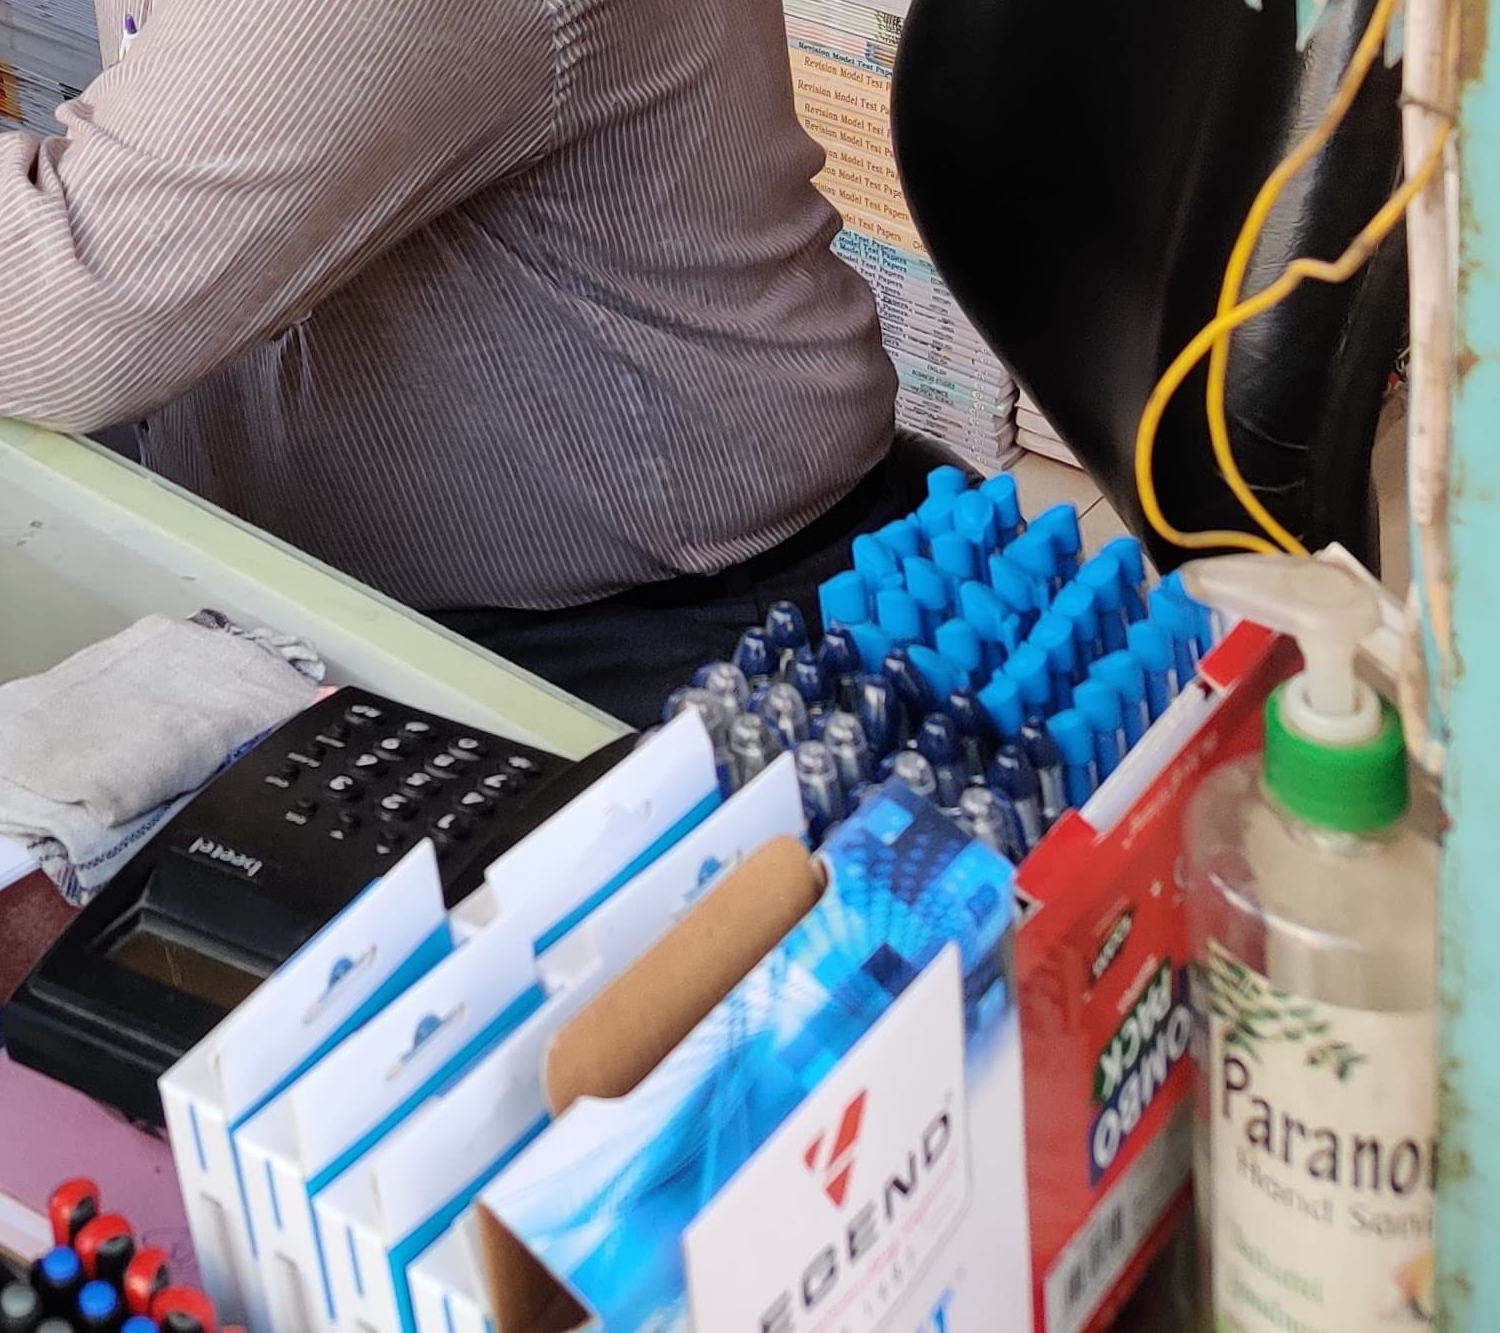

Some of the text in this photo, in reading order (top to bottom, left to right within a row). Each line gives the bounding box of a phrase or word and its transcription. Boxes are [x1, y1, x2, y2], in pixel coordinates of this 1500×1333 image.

[804, 57, 883, 88] Revision Model Test
[798, 79, 877, 111] Revision Model Test
[805, 103, 884, 135] Revision Model Test
[858, 219, 902, 242] Test Papers
[188, 835, 263, 878] beetel
